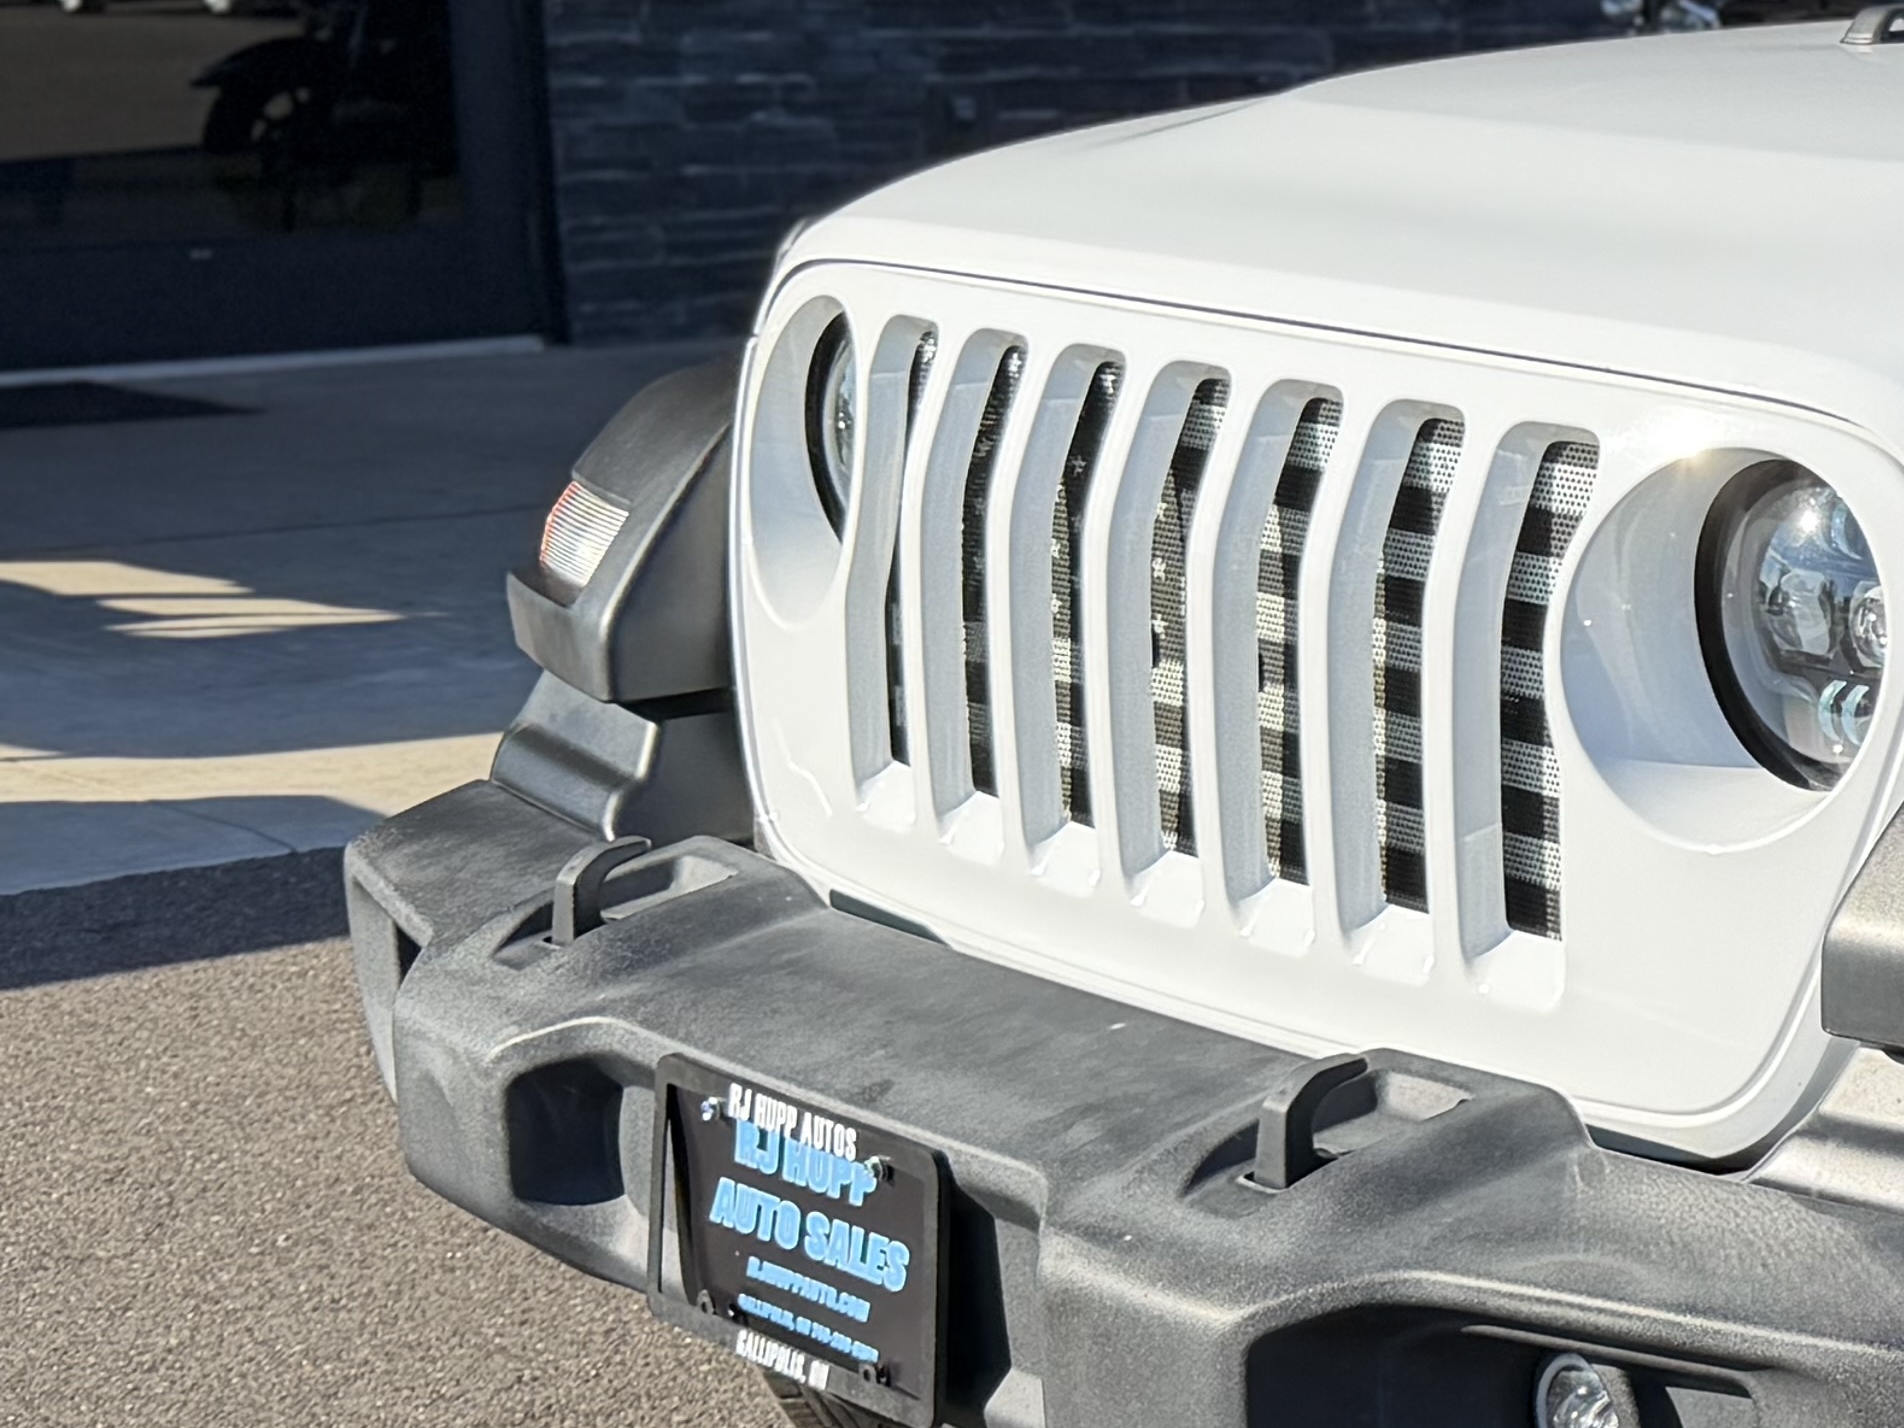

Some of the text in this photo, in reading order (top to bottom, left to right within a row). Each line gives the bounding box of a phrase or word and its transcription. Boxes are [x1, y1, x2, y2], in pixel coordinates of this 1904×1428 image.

[727, 1082, 857, 1161] RJ HUPP AUTOS
[734, 1119, 877, 1206] RJ HUPP
[709, 1176, 910, 1292] AUTO SALES
